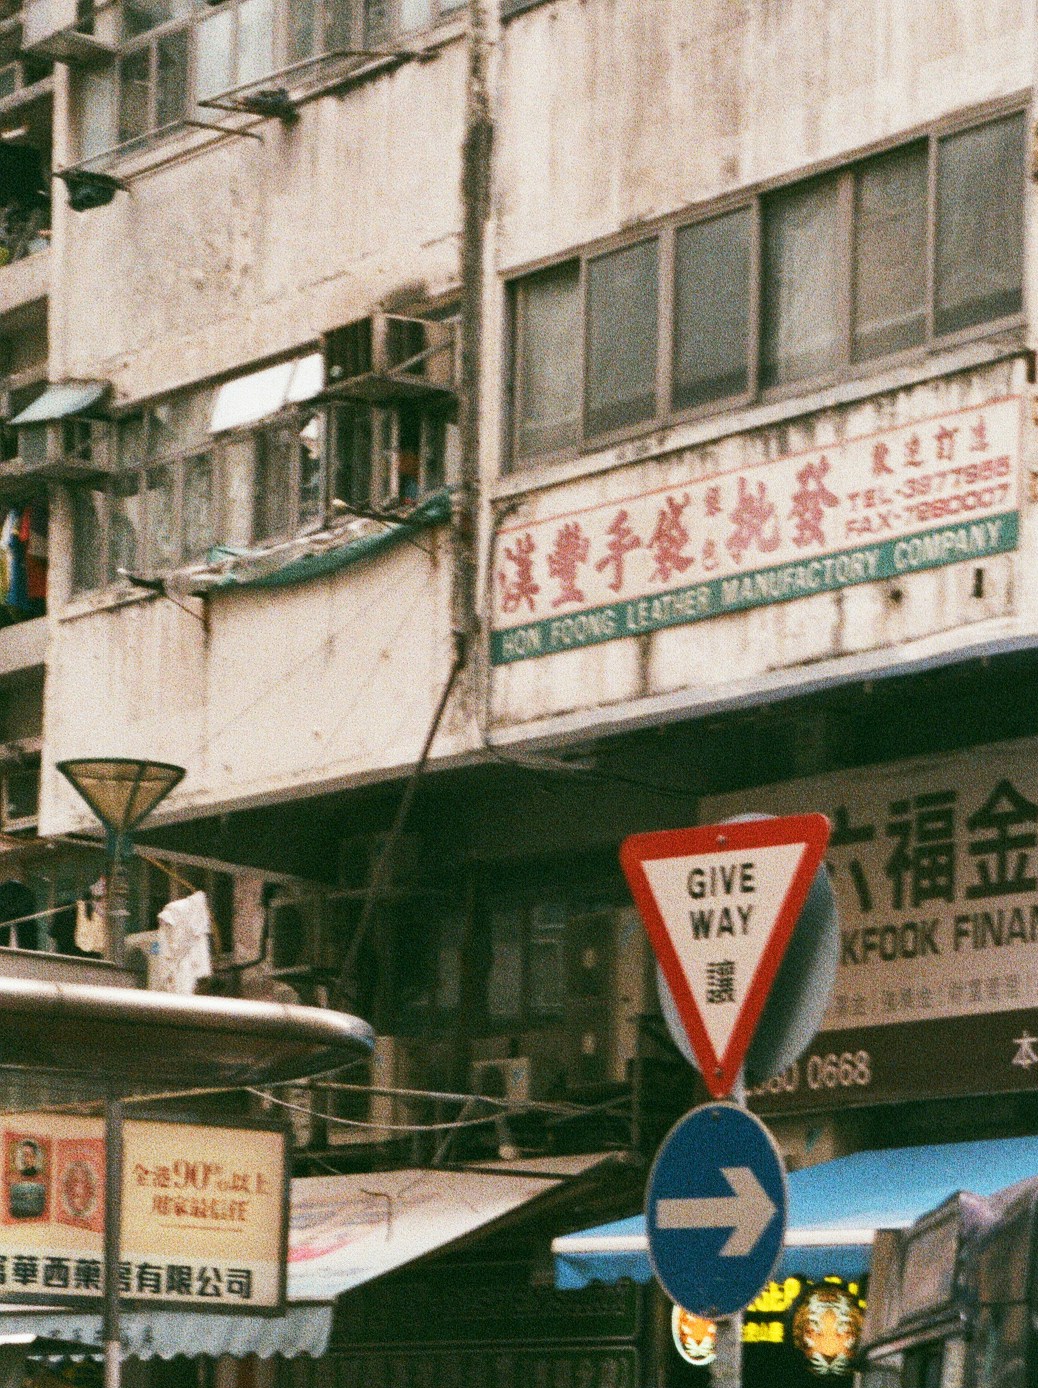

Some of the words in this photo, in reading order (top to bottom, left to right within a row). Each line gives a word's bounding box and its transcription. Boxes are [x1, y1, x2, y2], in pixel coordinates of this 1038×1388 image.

[626, 587, 713, 630] LEATHER
[722, 550, 880, 605] MANUFACTORY
[892, 519, 1002, 569] COMPANY
[686, 862, 756, 900] GIVE
[689, 904, 755, 941] WAY
[840, 917, 941, 966] KFOOK
[706, 958, 736, 1004] 讓
[807, 1049, 872, 1090] 0668
[0, 1254, 252, 1300] 華西藥有限公司
